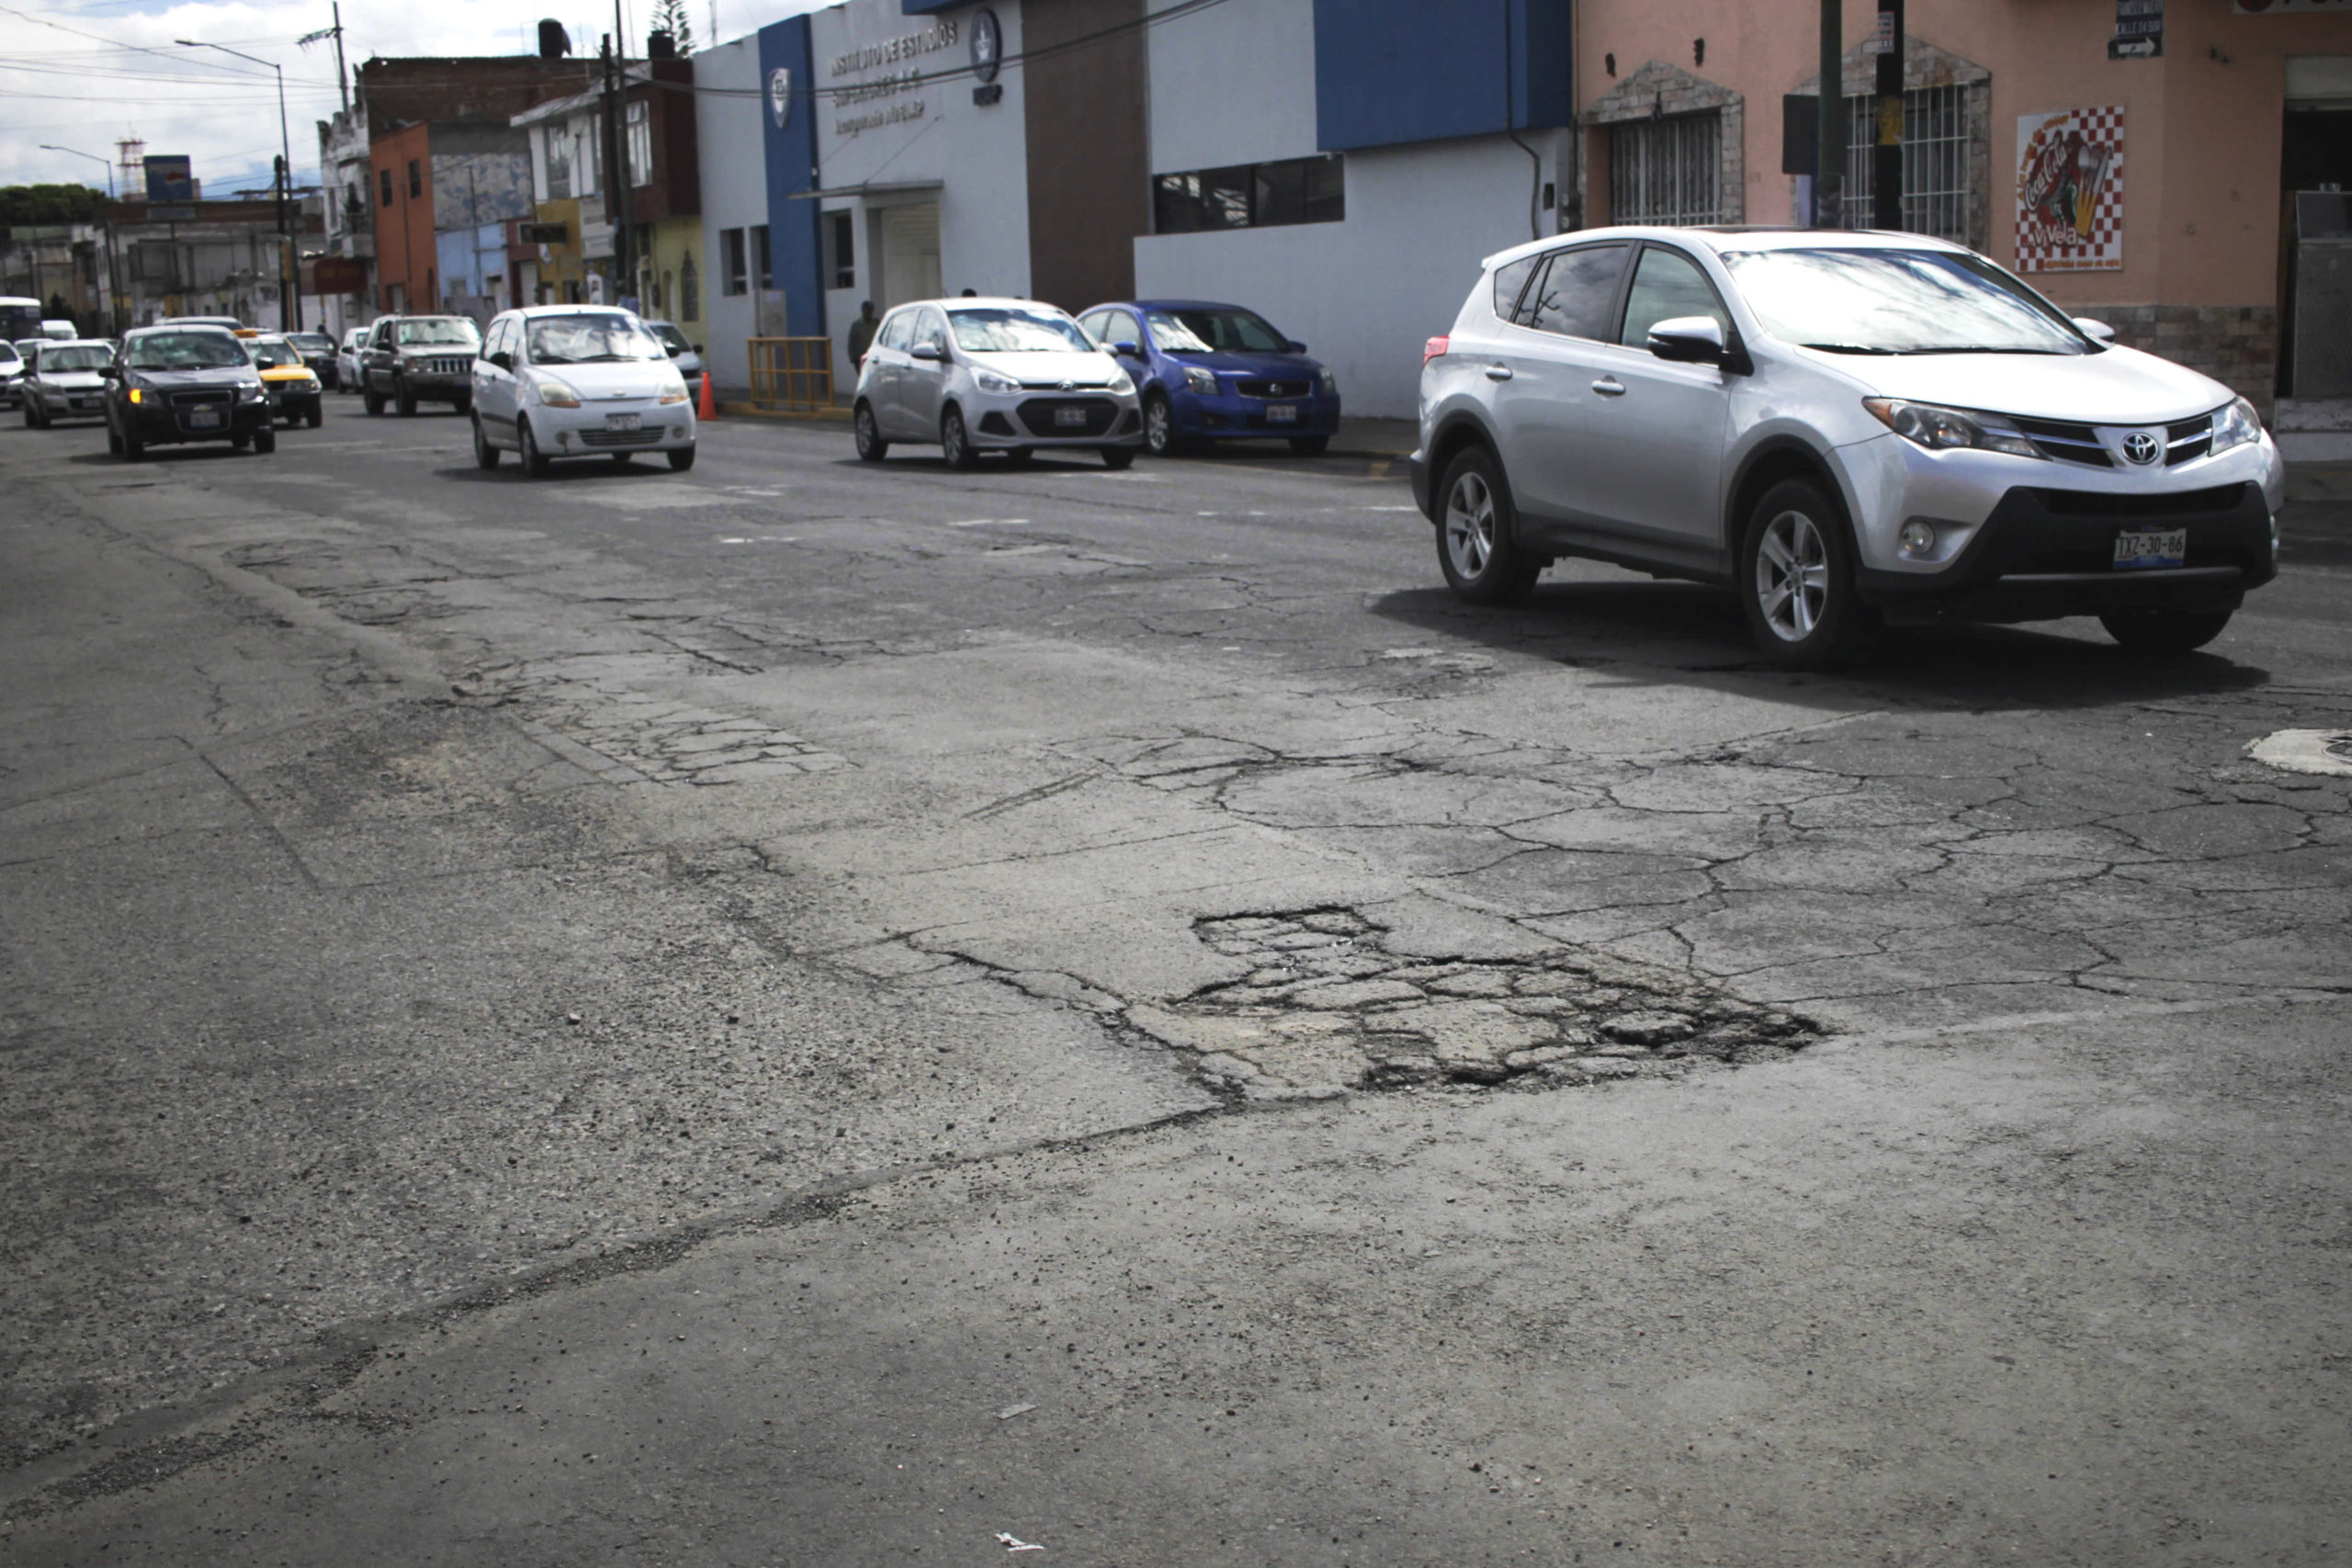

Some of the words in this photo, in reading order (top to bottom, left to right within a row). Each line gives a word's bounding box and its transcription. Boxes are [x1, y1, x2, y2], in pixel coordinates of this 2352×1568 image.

[831, 43, 883, 77] INSTITUTO
[884, 37, 900, 63] DE
[901, 21, 959, 60] ESTUDIOS
